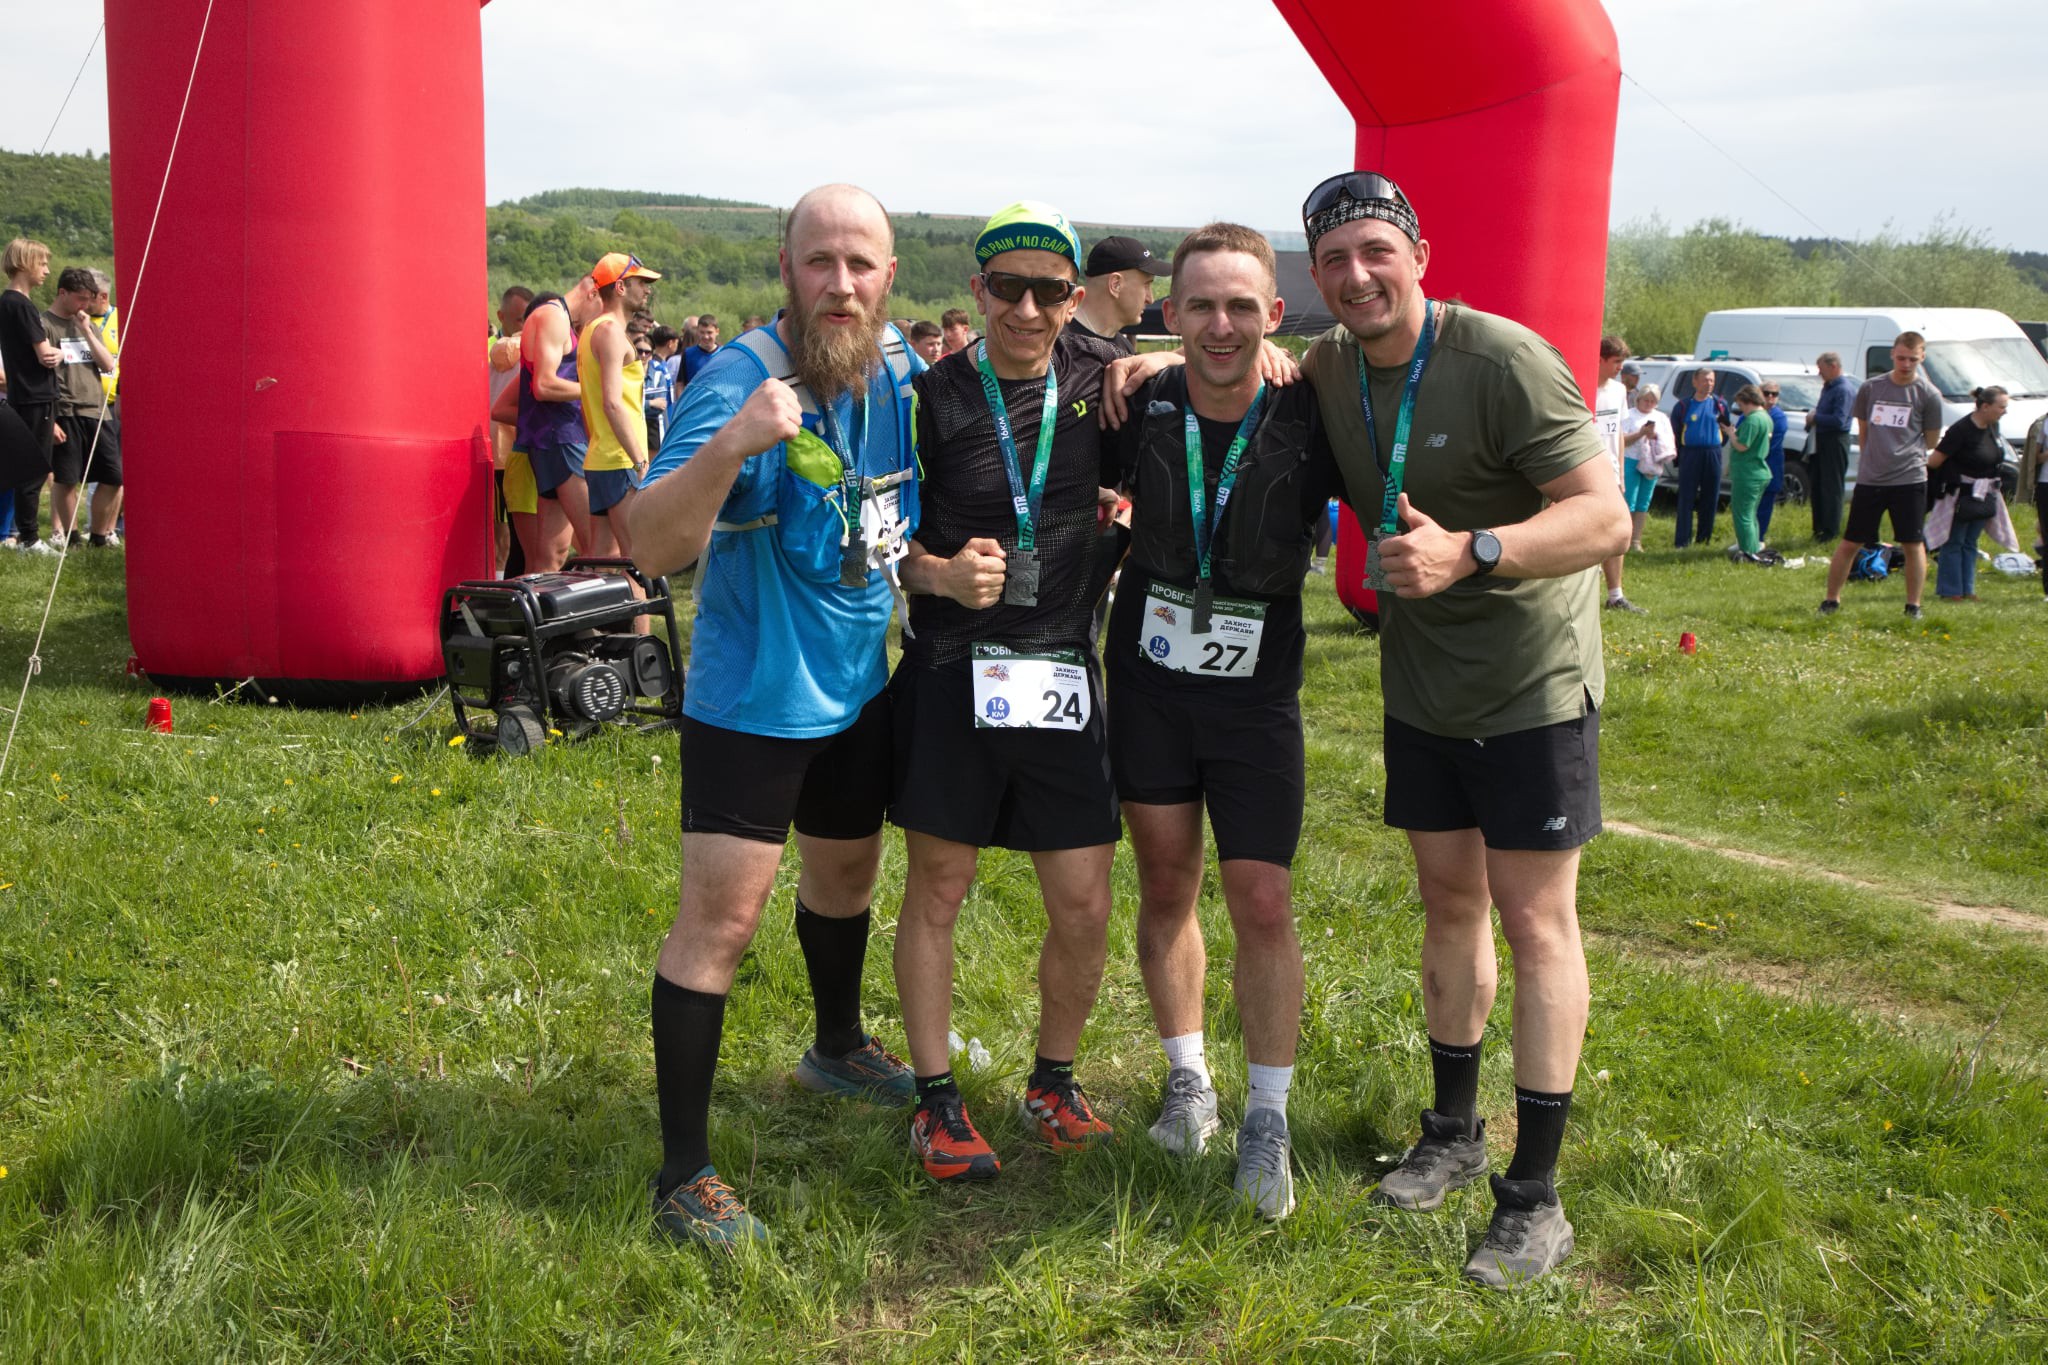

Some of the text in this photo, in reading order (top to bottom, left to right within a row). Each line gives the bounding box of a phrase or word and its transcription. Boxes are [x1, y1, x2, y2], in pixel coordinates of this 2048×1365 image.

[976, 235, 1070, 259] NO PAIN NO GAIN
[80, 350, 93, 361] 28
[1409, 359, 1425, 383] 16KM
[998, 416, 1010, 441] 16KM
[1186, 414, 1199, 433] GTR
[1606, 422, 1617, 433] 12
[1893, 414, 1905, 426] 16
[1392, 443, 1407, 463] GTR
[844, 467, 858, 487] GTR
[1033, 462, 1045, 485] 16KM
[1013, 495, 1029, 514] GTR
[1193, 488, 1202, 513] 16KM
[1216, 486, 1230, 506] GTR
[1151, 583, 1185, 602] ПРОБІГ
[1219, 625, 1254, 635] ДЕРЖАВИ
[1224, 619, 1252, 629] ЗАХИСТ
[1155, 637, 1166, 650] 16
[1199, 641, 1248, 673] 27
[1055, 666, 1079, 675] ЗАХИСТ
[991, 699, 1006, 711] 16
[1042, 689, 1083, 725] 24
[1518, 1095, 1561, 1107] omon
